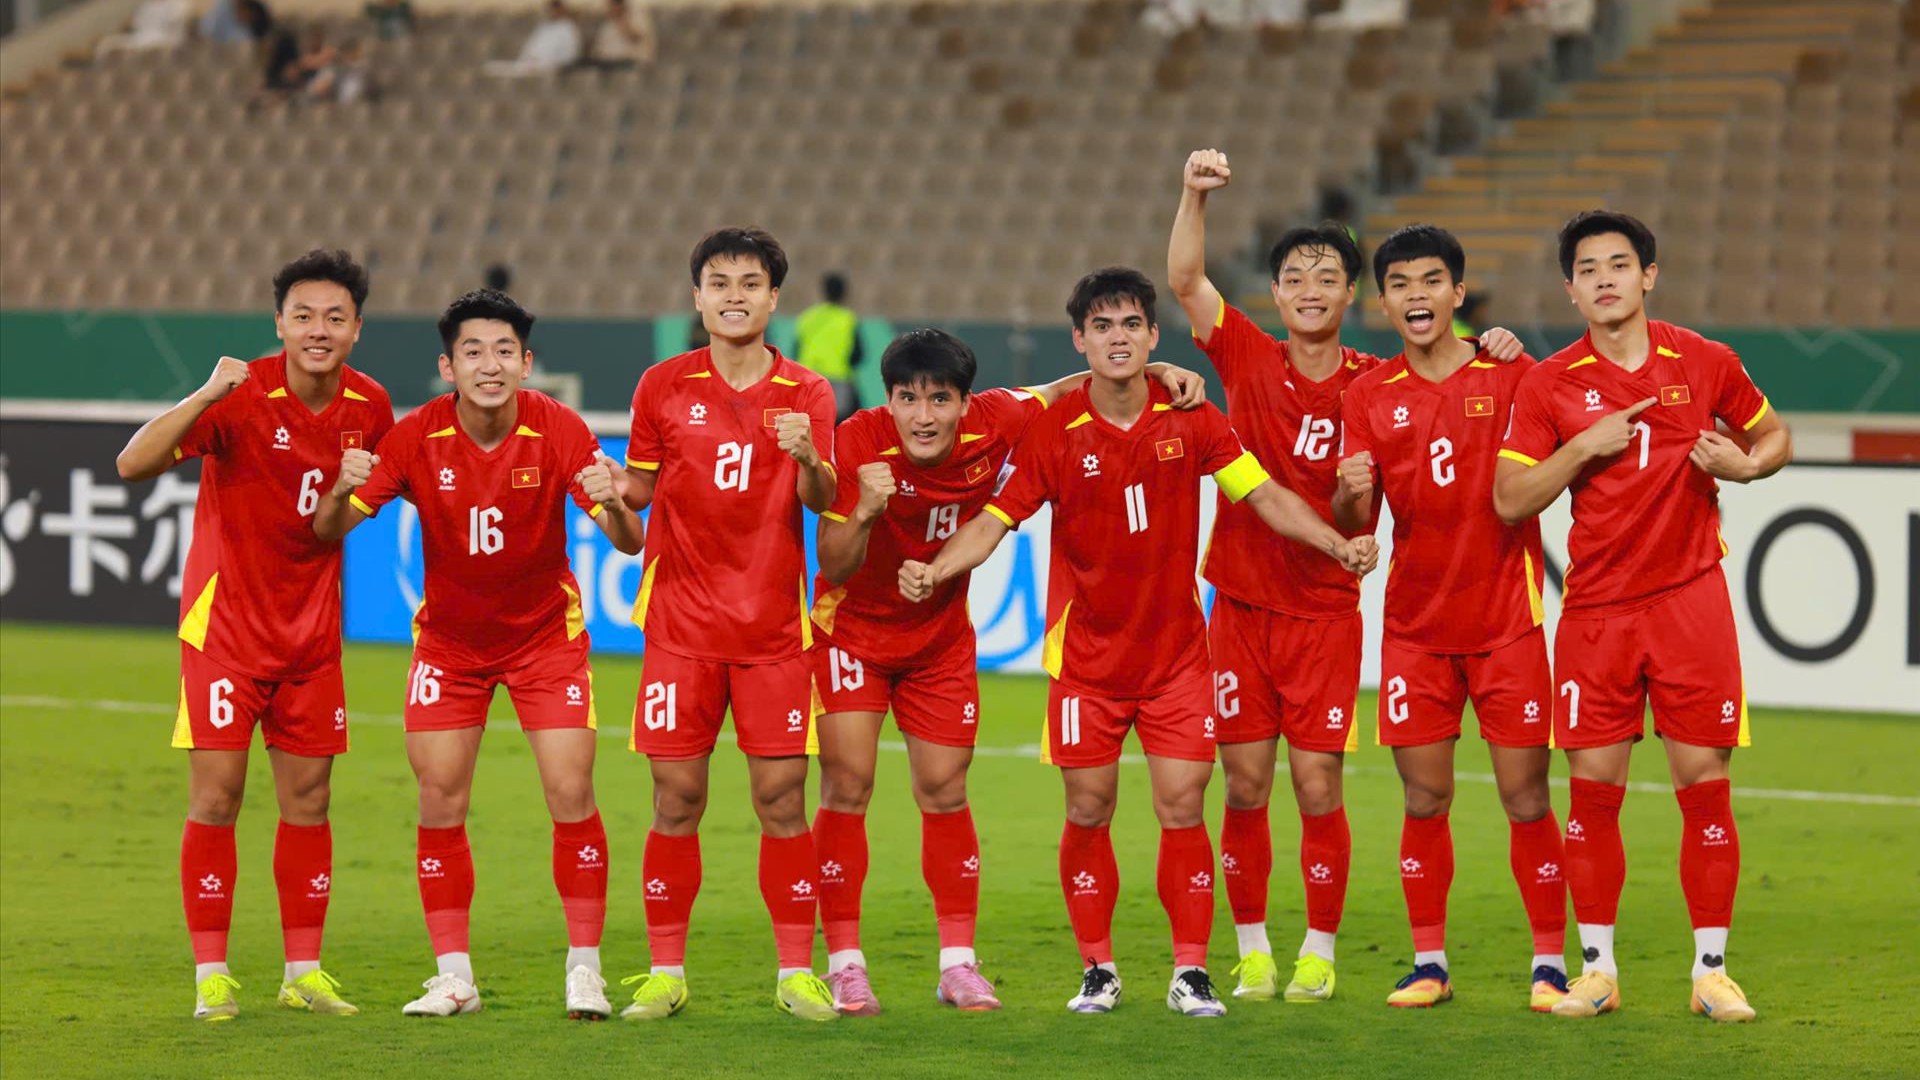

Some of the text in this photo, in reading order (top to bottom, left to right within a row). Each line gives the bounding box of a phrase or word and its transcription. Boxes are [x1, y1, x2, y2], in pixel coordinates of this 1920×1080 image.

[1293, 415, 1335, 461] 12
[1429, 436, 1456, 487] 2
[1634, 420, 1651, 470] 7
[713, 441, 753, 492] 21
[296, 468, 324, 517] 6
[1124, 482, 1149, 534] 11
[469, 505, 504, 556] 16
[925, 503, 961, 543] 19
[409, 660, 444, 706] 16
[829, 647, 865, 693] 19
[209, 677, 234, 729] 6
[644, 680, 677, 732] 21
[1061, 696, 1081, 746] 11
[1387, 675, 1409, 725] 2
[1560, 679, 1580, 729] 7
